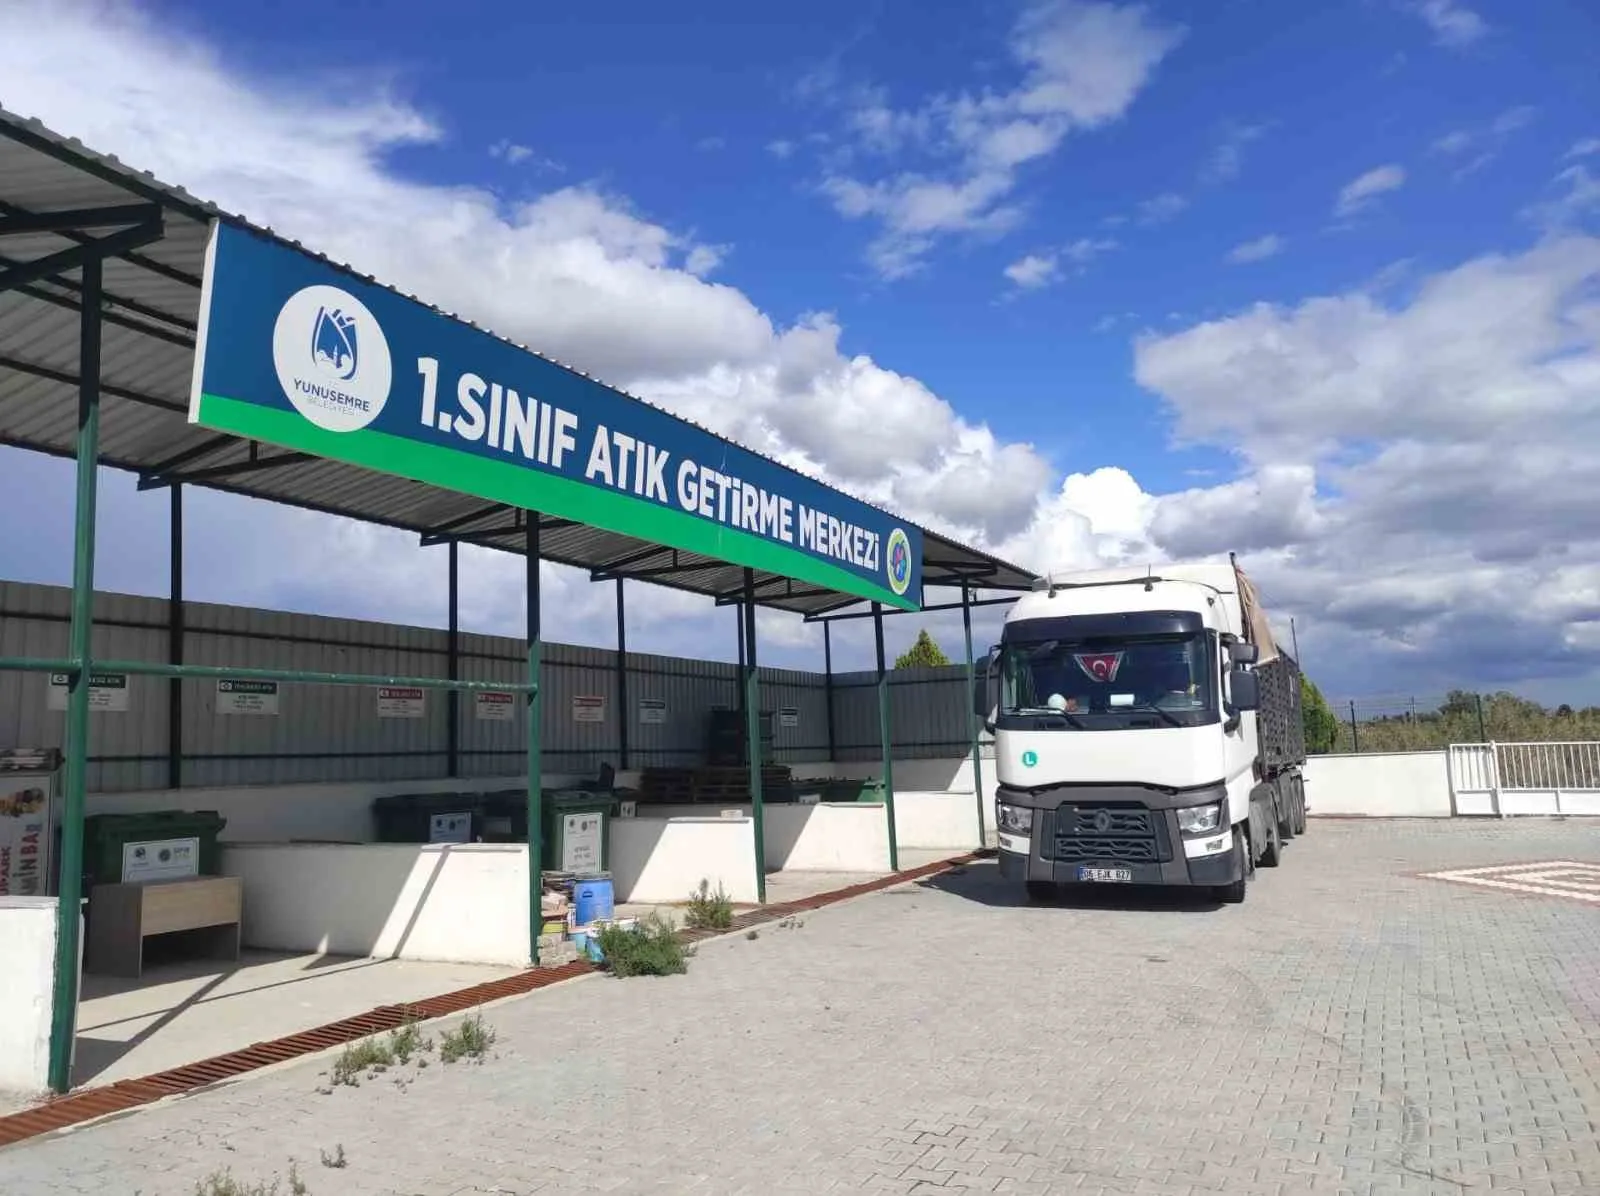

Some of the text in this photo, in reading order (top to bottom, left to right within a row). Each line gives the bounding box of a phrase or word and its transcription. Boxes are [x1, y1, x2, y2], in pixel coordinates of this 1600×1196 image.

[294, 378, 370, 412] YUNUSEMRE
[417, 357, 578, 469] 1.SINIF
[585, 424, 670, 503] ATIK
[677, 459, 793, 543] GETİRME
[798, 504, 880, 572] MERKEZİ
